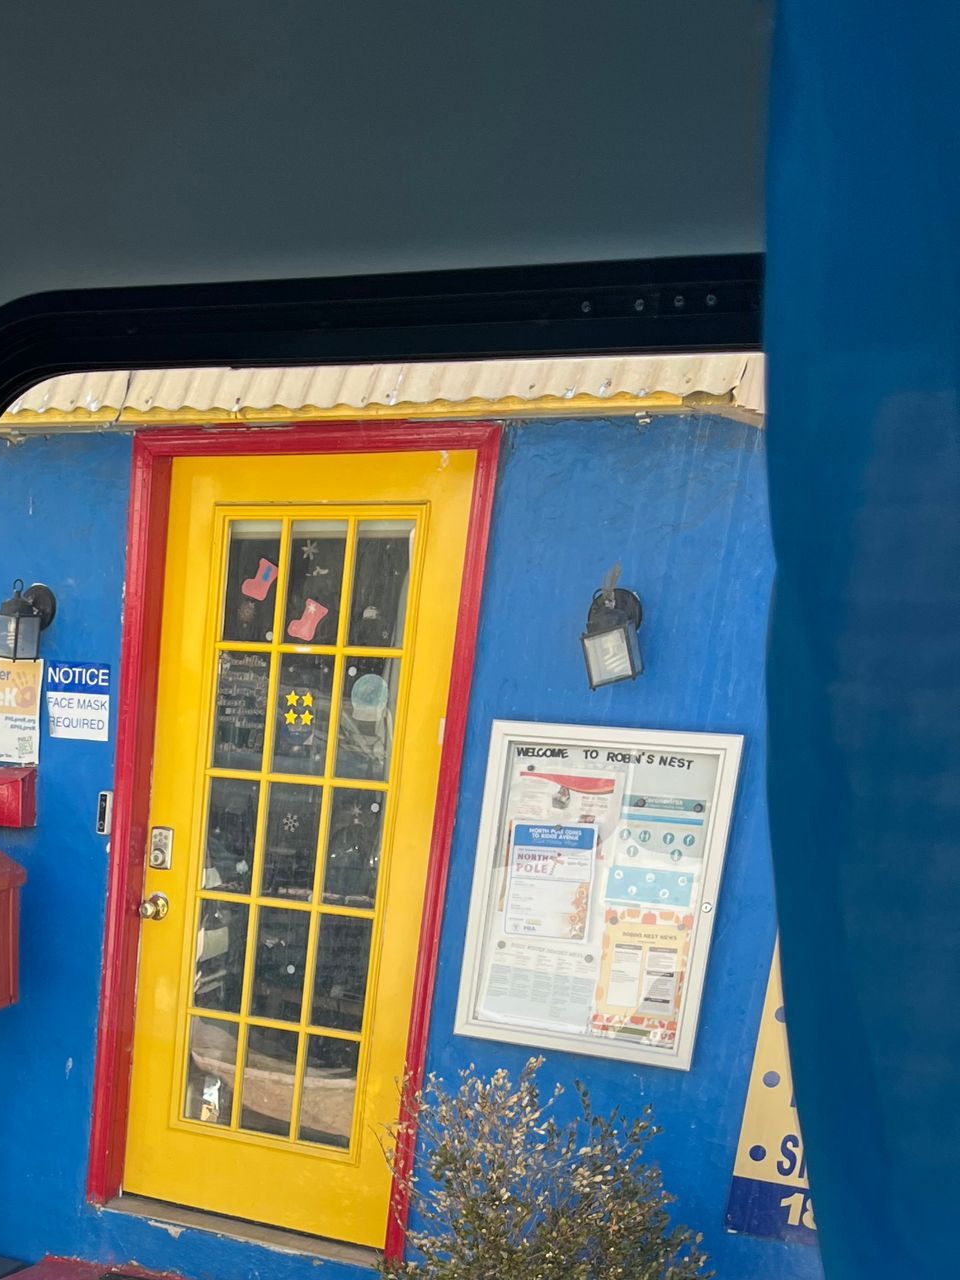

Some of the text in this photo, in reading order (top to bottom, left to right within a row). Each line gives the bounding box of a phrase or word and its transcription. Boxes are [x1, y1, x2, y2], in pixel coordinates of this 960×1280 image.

[48, 667, 109, 686] NOTICE
[48, 697, 107, 711] FACE MASK
[50, 716, 104, 730] REQUIRED
[516, 747, 569, 758] WELCOME
[583, 750, 599, 760] TO
[659, 756, 694, 770] NEST
[518, 853, 548, 861] NORTH
[516, 863, 548, 874] POLE
